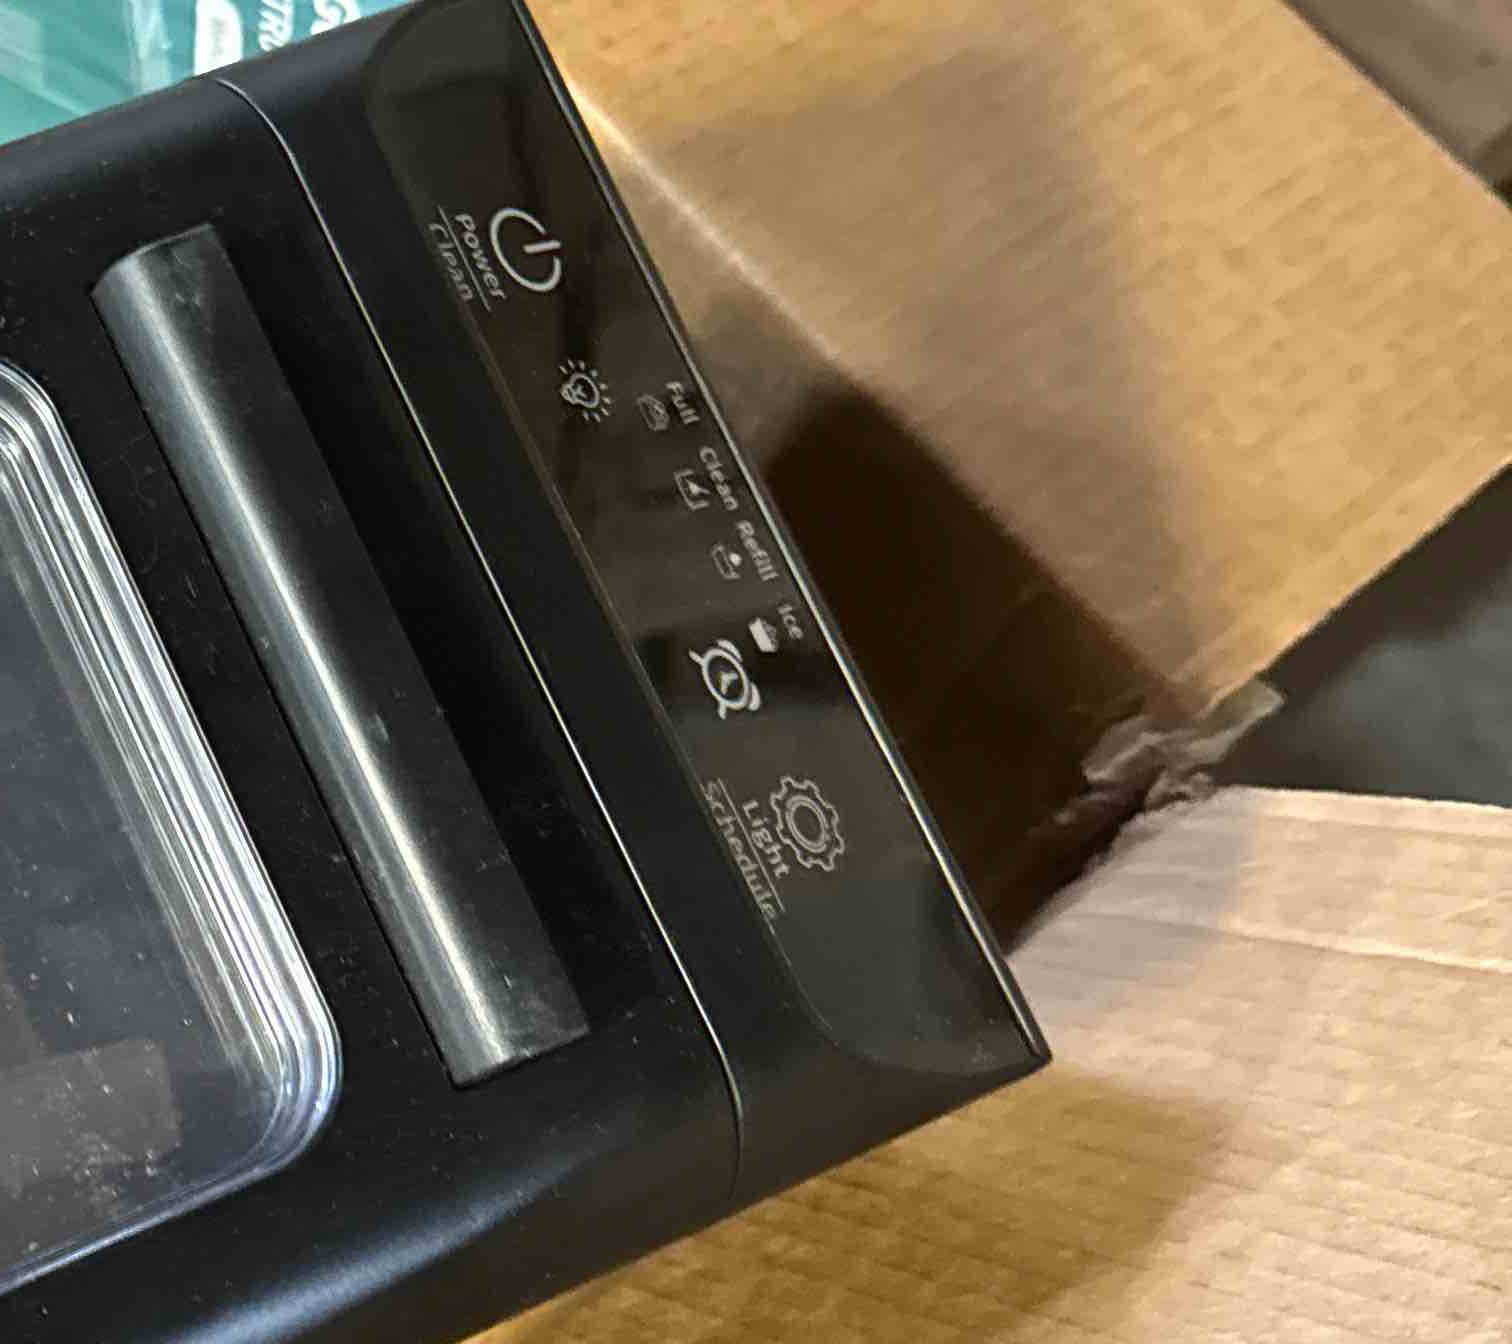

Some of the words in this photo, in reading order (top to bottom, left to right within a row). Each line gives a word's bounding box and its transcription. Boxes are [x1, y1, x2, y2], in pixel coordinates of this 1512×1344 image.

[428, 222, 474, 302] Clean
[454, 213, 508, 300] Power
[665, 380, 701, 425] Full
[698, 445, 739, 512] Clean
[736, 518, 780, 583] Refill
[776, 603, 805, 641] Ice
[698, 780, 778, 920] Schedule
[742, 799, 791, 880] Light
